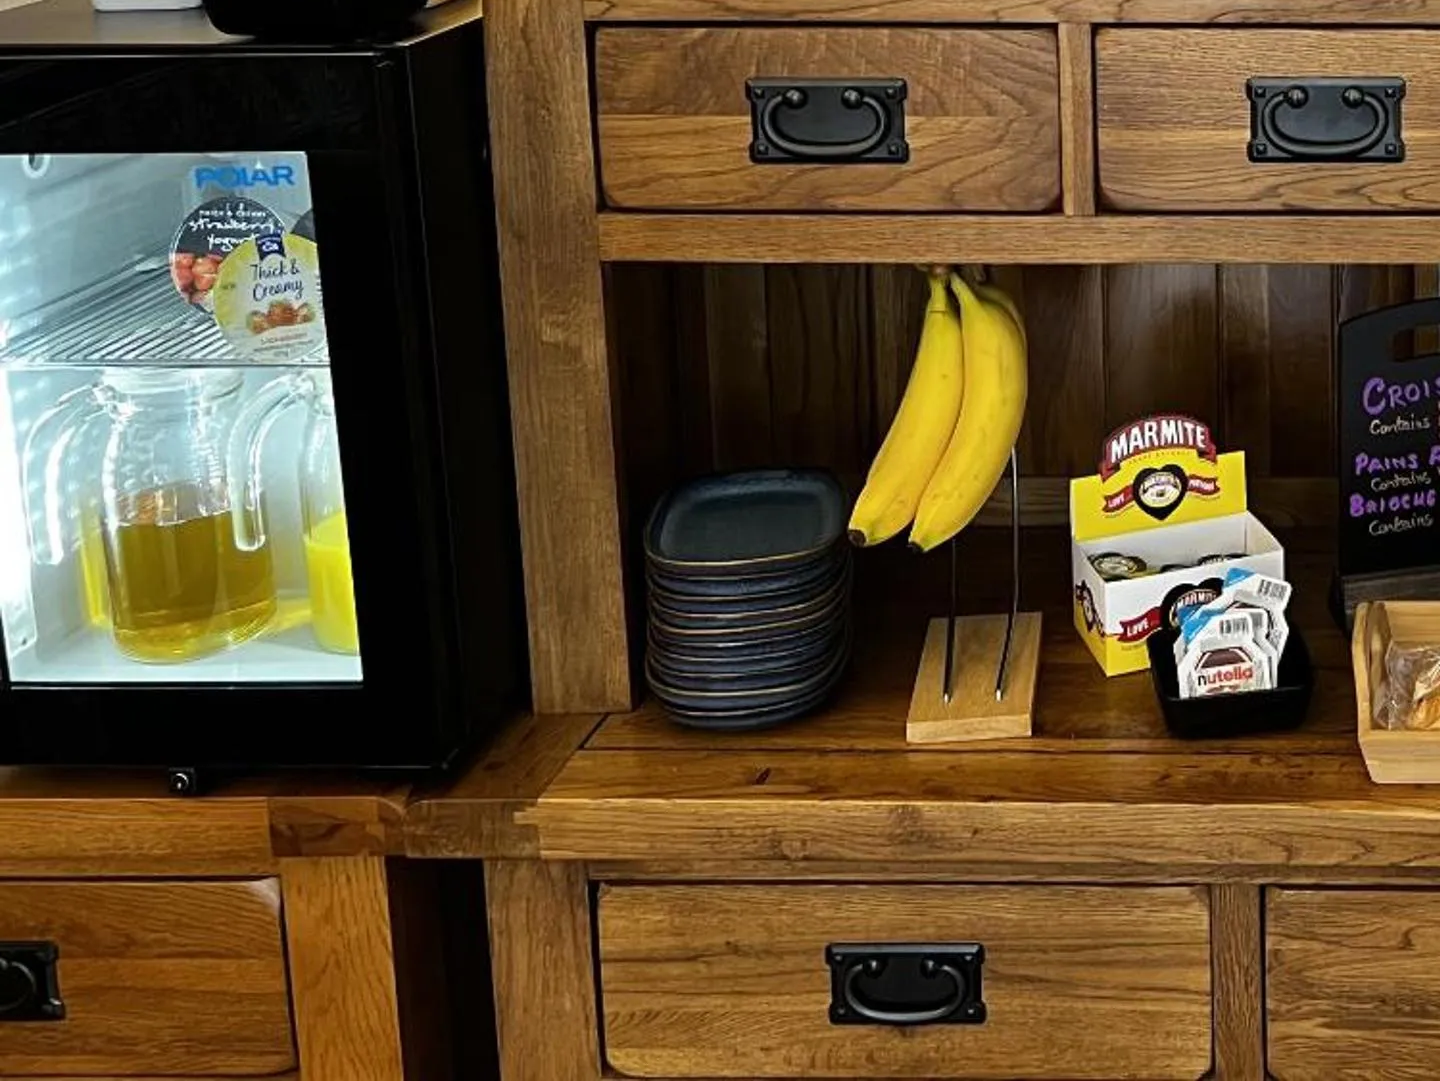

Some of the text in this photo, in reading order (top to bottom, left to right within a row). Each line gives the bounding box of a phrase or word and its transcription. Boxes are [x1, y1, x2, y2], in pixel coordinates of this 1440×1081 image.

[195, 164, 296, 189] POLAR
[250, 260, 288, 281] Thick
[253, 280, 304, 302] Creamy
[1369, 413, 1431, 435] Contains
[1111, 419, 1207, 464] MARMITE
[1355, 452, 1419, 476] PAINS
[1370, 471, 1432, 492] Contains
[1350, 490, 1437, 517] BRIOCHE
[1368, 513, 1434, 536] Contains
[1127, 618, 1150, 636] LOVE
[1198, 665, 1254, 686] nutella
